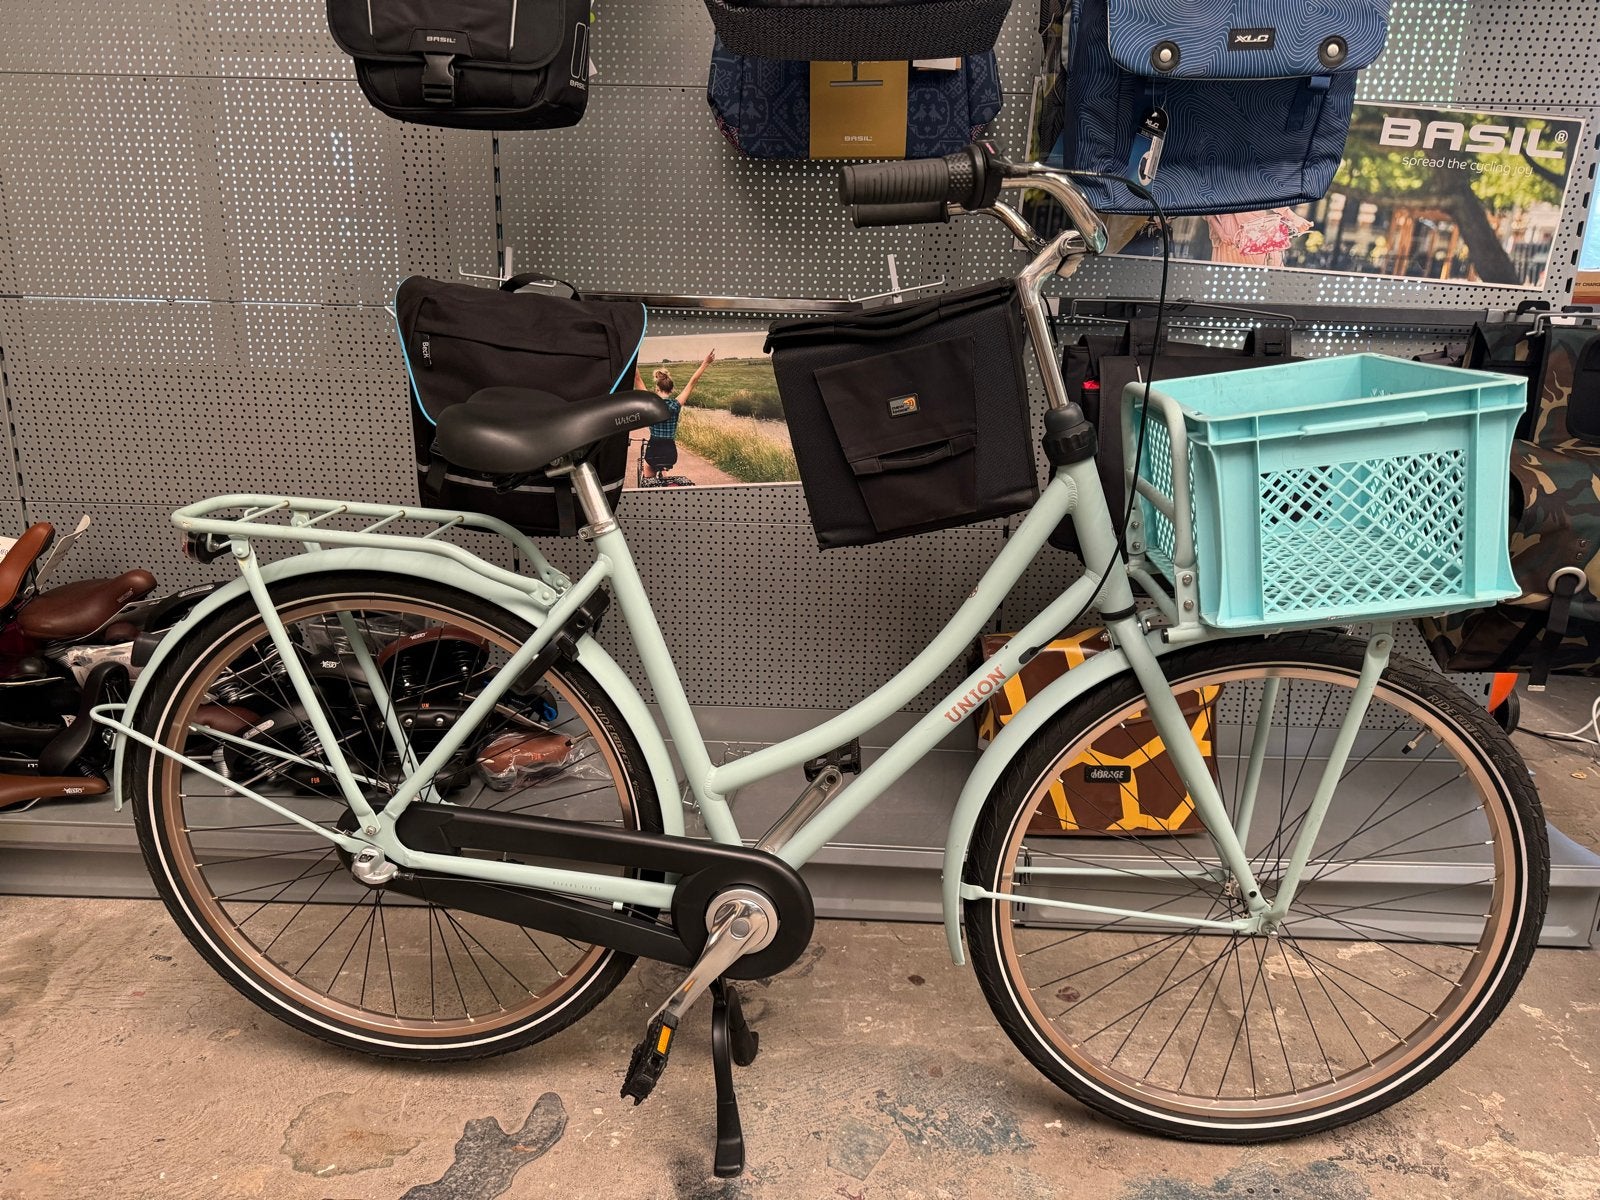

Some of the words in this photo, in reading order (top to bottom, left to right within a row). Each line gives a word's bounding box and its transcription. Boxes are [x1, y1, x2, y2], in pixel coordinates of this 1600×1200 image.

[426, 35, 456, 44] BASIL
[1234, 34, 1269, 43] XLC
[1145, 118, 1160, 129] XLC
[1401, 156, 1445, 169] spread
[1447, 158, 1468, 170] the
[1469, 161, 1511, 175] cycling
[1511, 163, 1534, 177] joy
[944, 665, 1007, 723] UNION
[1426, 694, 1458, 716] RIDE
[593, 705, 616, 732] RIDE
